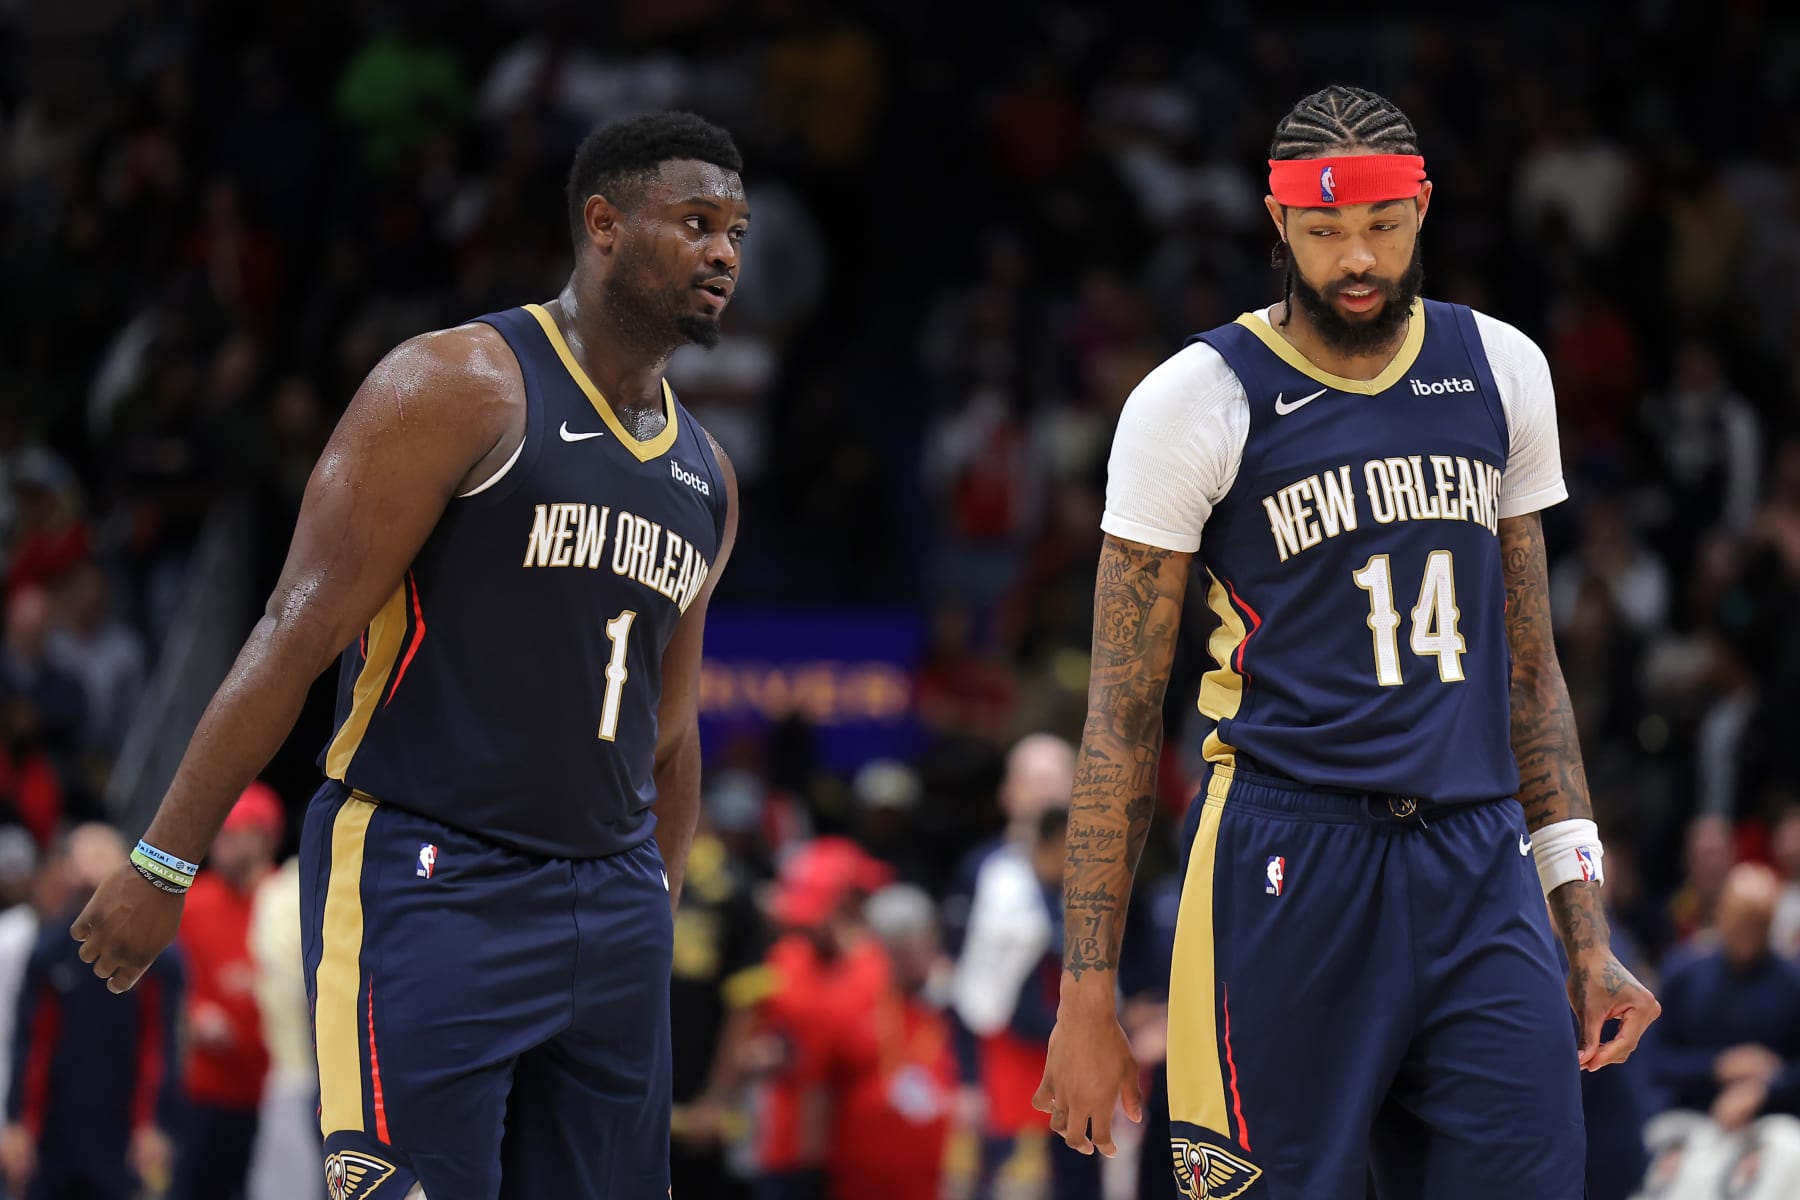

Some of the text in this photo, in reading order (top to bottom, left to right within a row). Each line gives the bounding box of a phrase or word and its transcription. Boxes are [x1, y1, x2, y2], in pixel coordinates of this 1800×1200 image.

[1409, 377, 1476, 397] ibotta
[669, 459, 710, 496] ibotta
[1262, 455, 1501, 563] NEW ORLEANS
[523, 503, 610, 570] NEW
[1352, 549, 1468, 687] 14
[598, 609, 638, 743] 1
